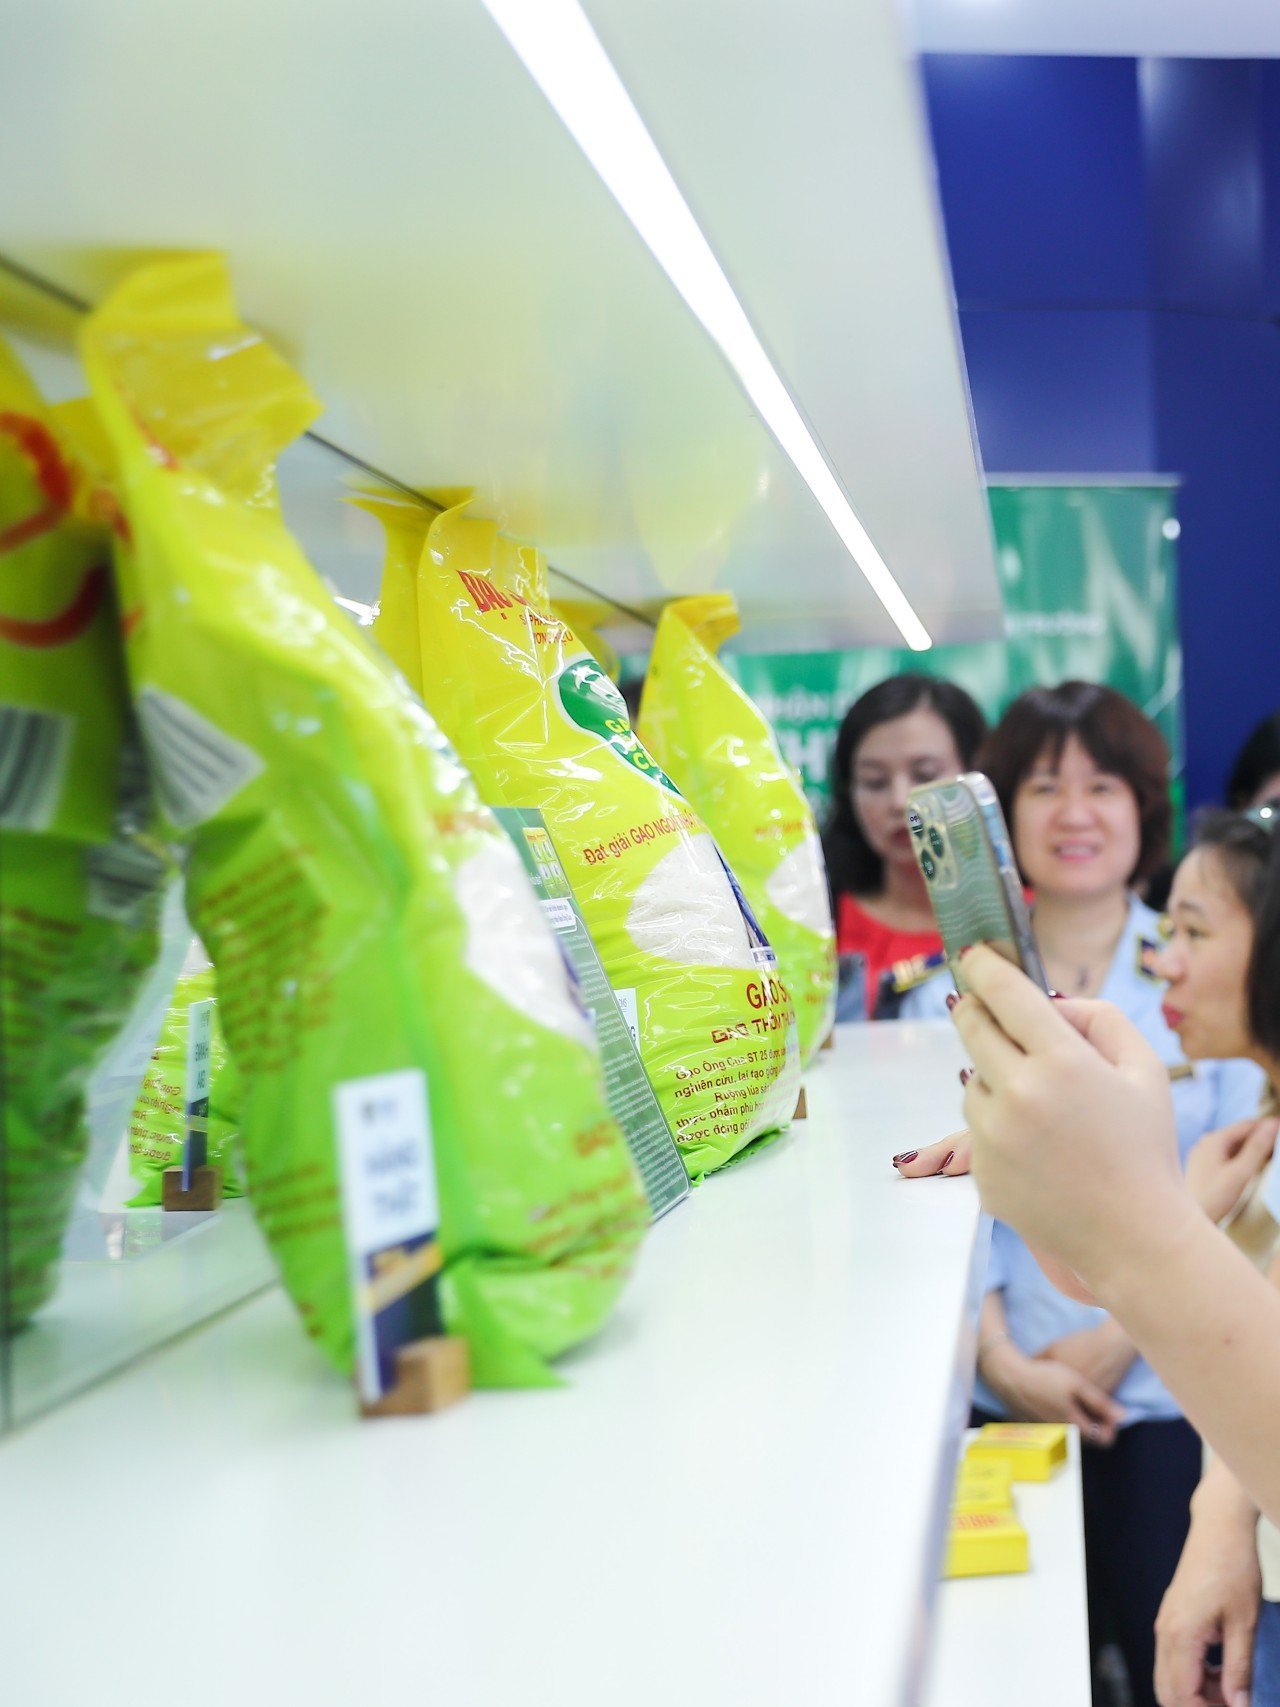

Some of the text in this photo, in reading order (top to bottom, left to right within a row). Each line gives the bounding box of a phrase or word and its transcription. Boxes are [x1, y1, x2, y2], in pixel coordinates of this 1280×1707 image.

[583, 844, 608, 866] Đạt
[608, 832, 632, 858] giải
[630, 822, 656, 846] GẠO
[702, 1060, 727, 1073] Ông
[747, 1050, 758, 1063] ST
[759, 1049, 769, 1061] 25
[750, 1068, 765, 1081] tạo
